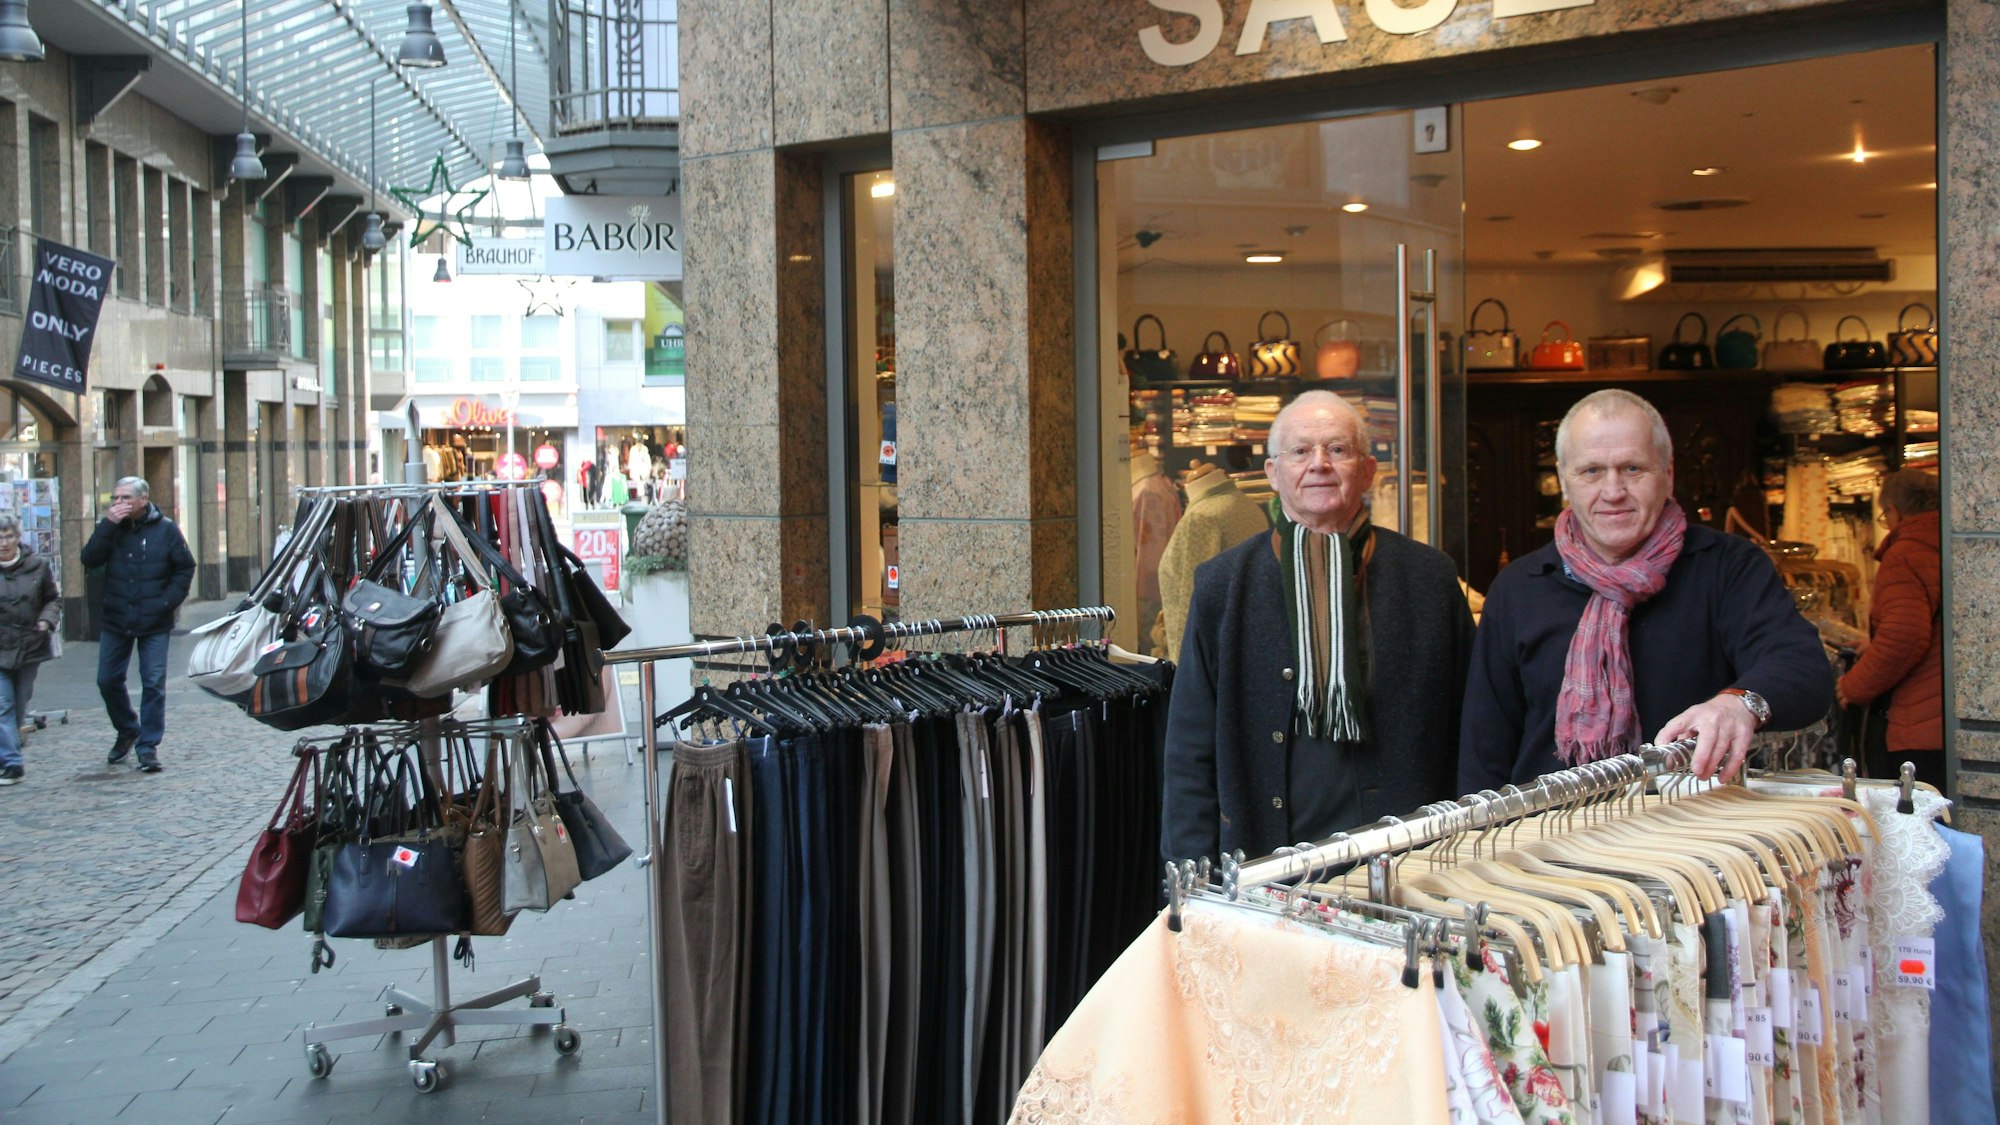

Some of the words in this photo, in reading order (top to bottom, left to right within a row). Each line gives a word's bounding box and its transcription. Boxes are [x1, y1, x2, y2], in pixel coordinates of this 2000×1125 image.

[554, 222, 678, 251] BABOR
[466, 248, 536, 264] BRAUHOF
[46, 252, 102, 281] VERO
[37, 268, 99, 300] MODA
[32, 310, 89, 342] ONLY
[22, 355, 82, 383] PIECES
[1837, 978, 1848, 986] 85
[1926, 977, 1932, 986] €
[1755, 1014, 1766, 1022] 85
[1842, 1011, 1849, 1020] €
[1812, 1033, 1819, 1042] €
[1764, 1053, 1771, 1062] €
